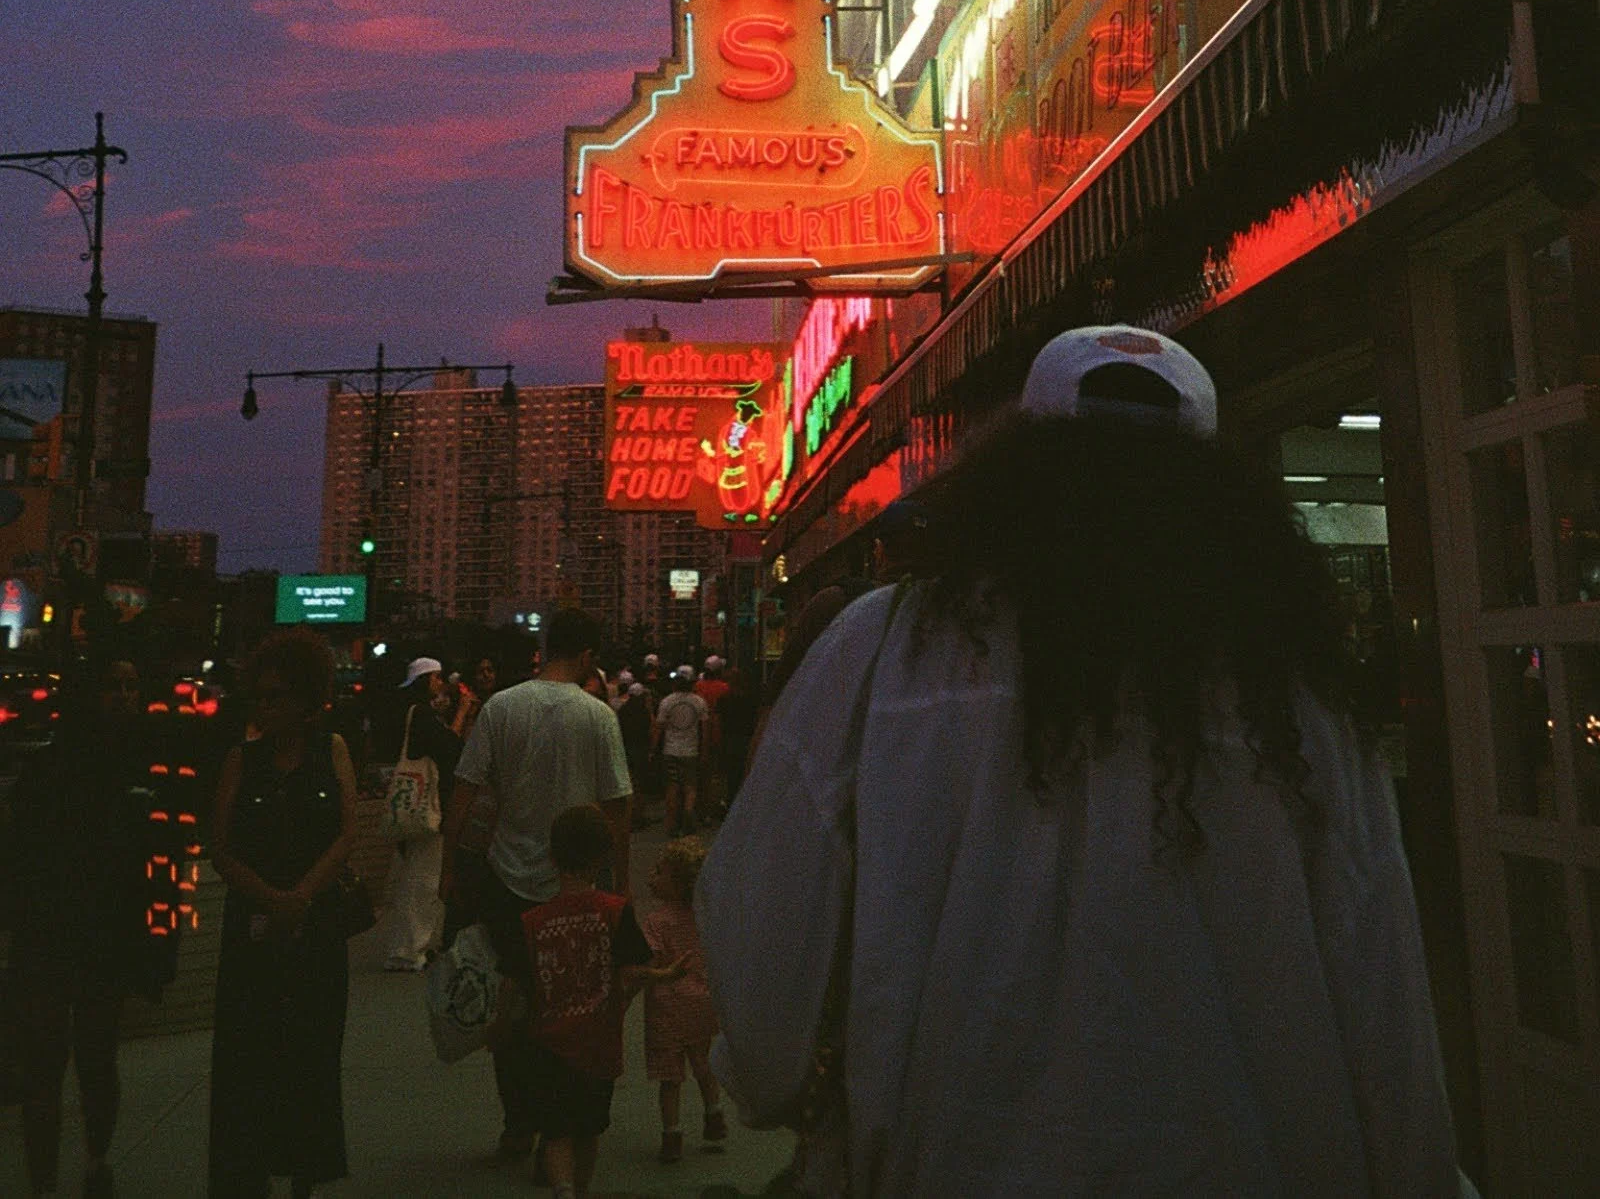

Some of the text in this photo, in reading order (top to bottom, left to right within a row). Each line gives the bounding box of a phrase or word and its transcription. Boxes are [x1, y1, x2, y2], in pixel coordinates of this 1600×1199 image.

[675, 134, 849, 170] FAMOUS
[587, 163, 936, 253] FRANKFURTERS
[614, 406, 698, 431] TAKE
[610, 436, 698, 463] HOME
[606, 467, 696, 501] FOOD
[341, 586, 355, 596] to
